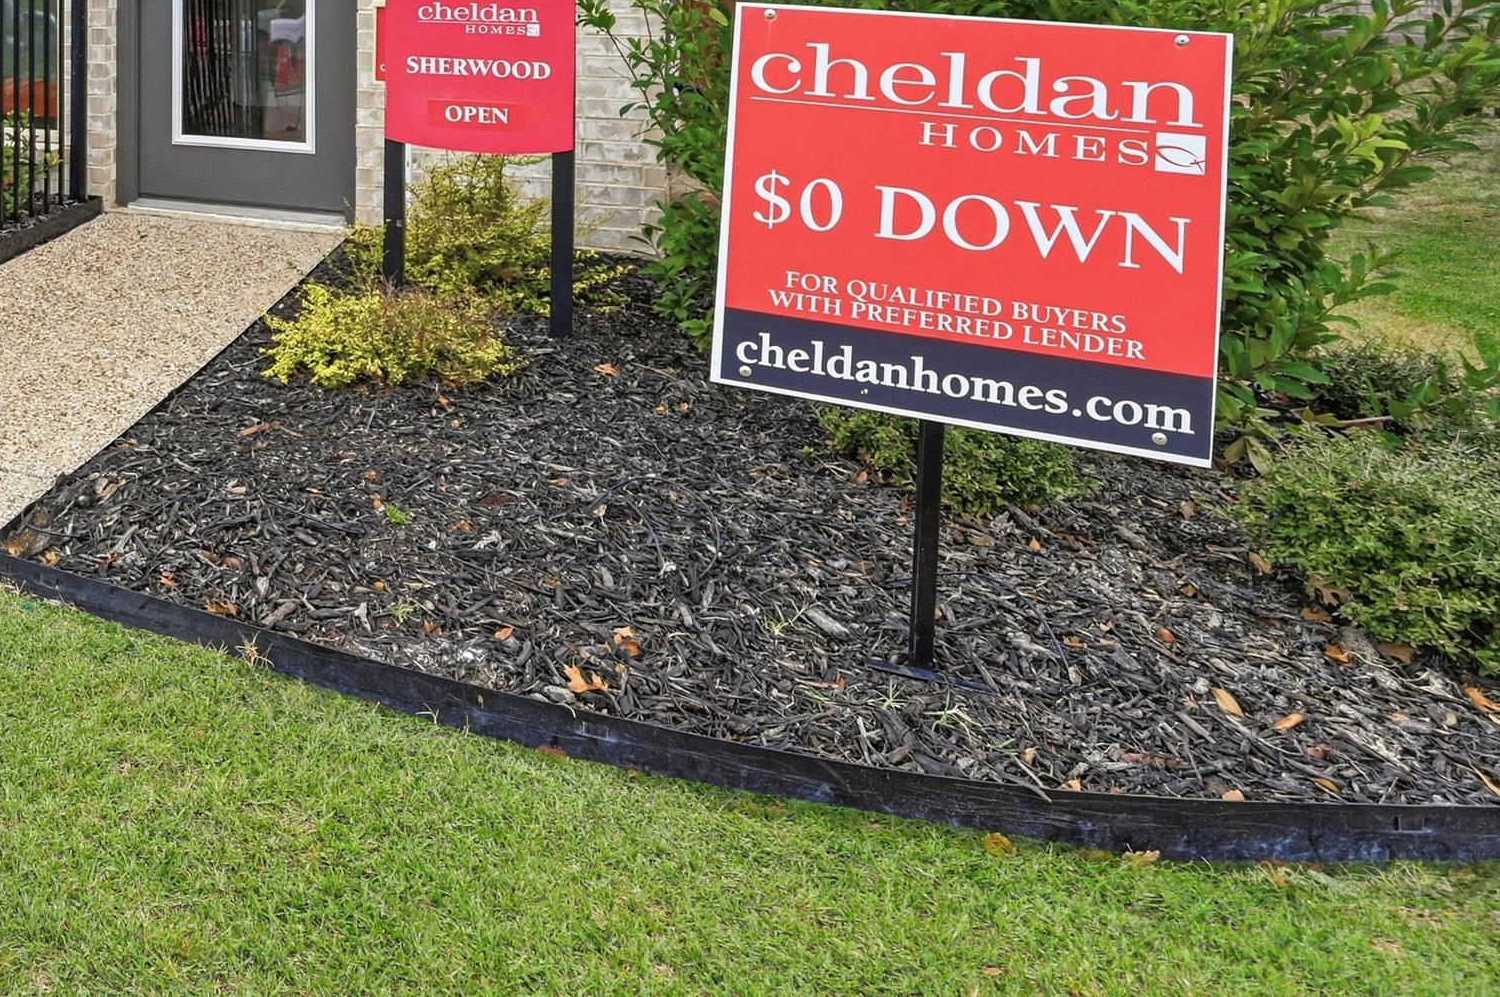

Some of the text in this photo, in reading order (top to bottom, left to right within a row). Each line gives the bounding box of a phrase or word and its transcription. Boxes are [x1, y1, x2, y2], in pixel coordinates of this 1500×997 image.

[417, 1, 539, 23] cheldan
[465, 24, 526, 35] HOMES
[406, 55, 551, 80] SHERWOOD
[751, 42, 1204, 128] cheldan
[444, 105, 509, 124] OPEN
[918, 121, 1150, 166] HOMES
[752, 169, 1192, 275] $0 DOWN
[768, 288, 1146, 360] WITH PREFERRED LENDER
[785, 270, 1126, 334] FOR QUALIFIED BUYERS
[736, 332, 1195, 435] cheldanhomes.com
